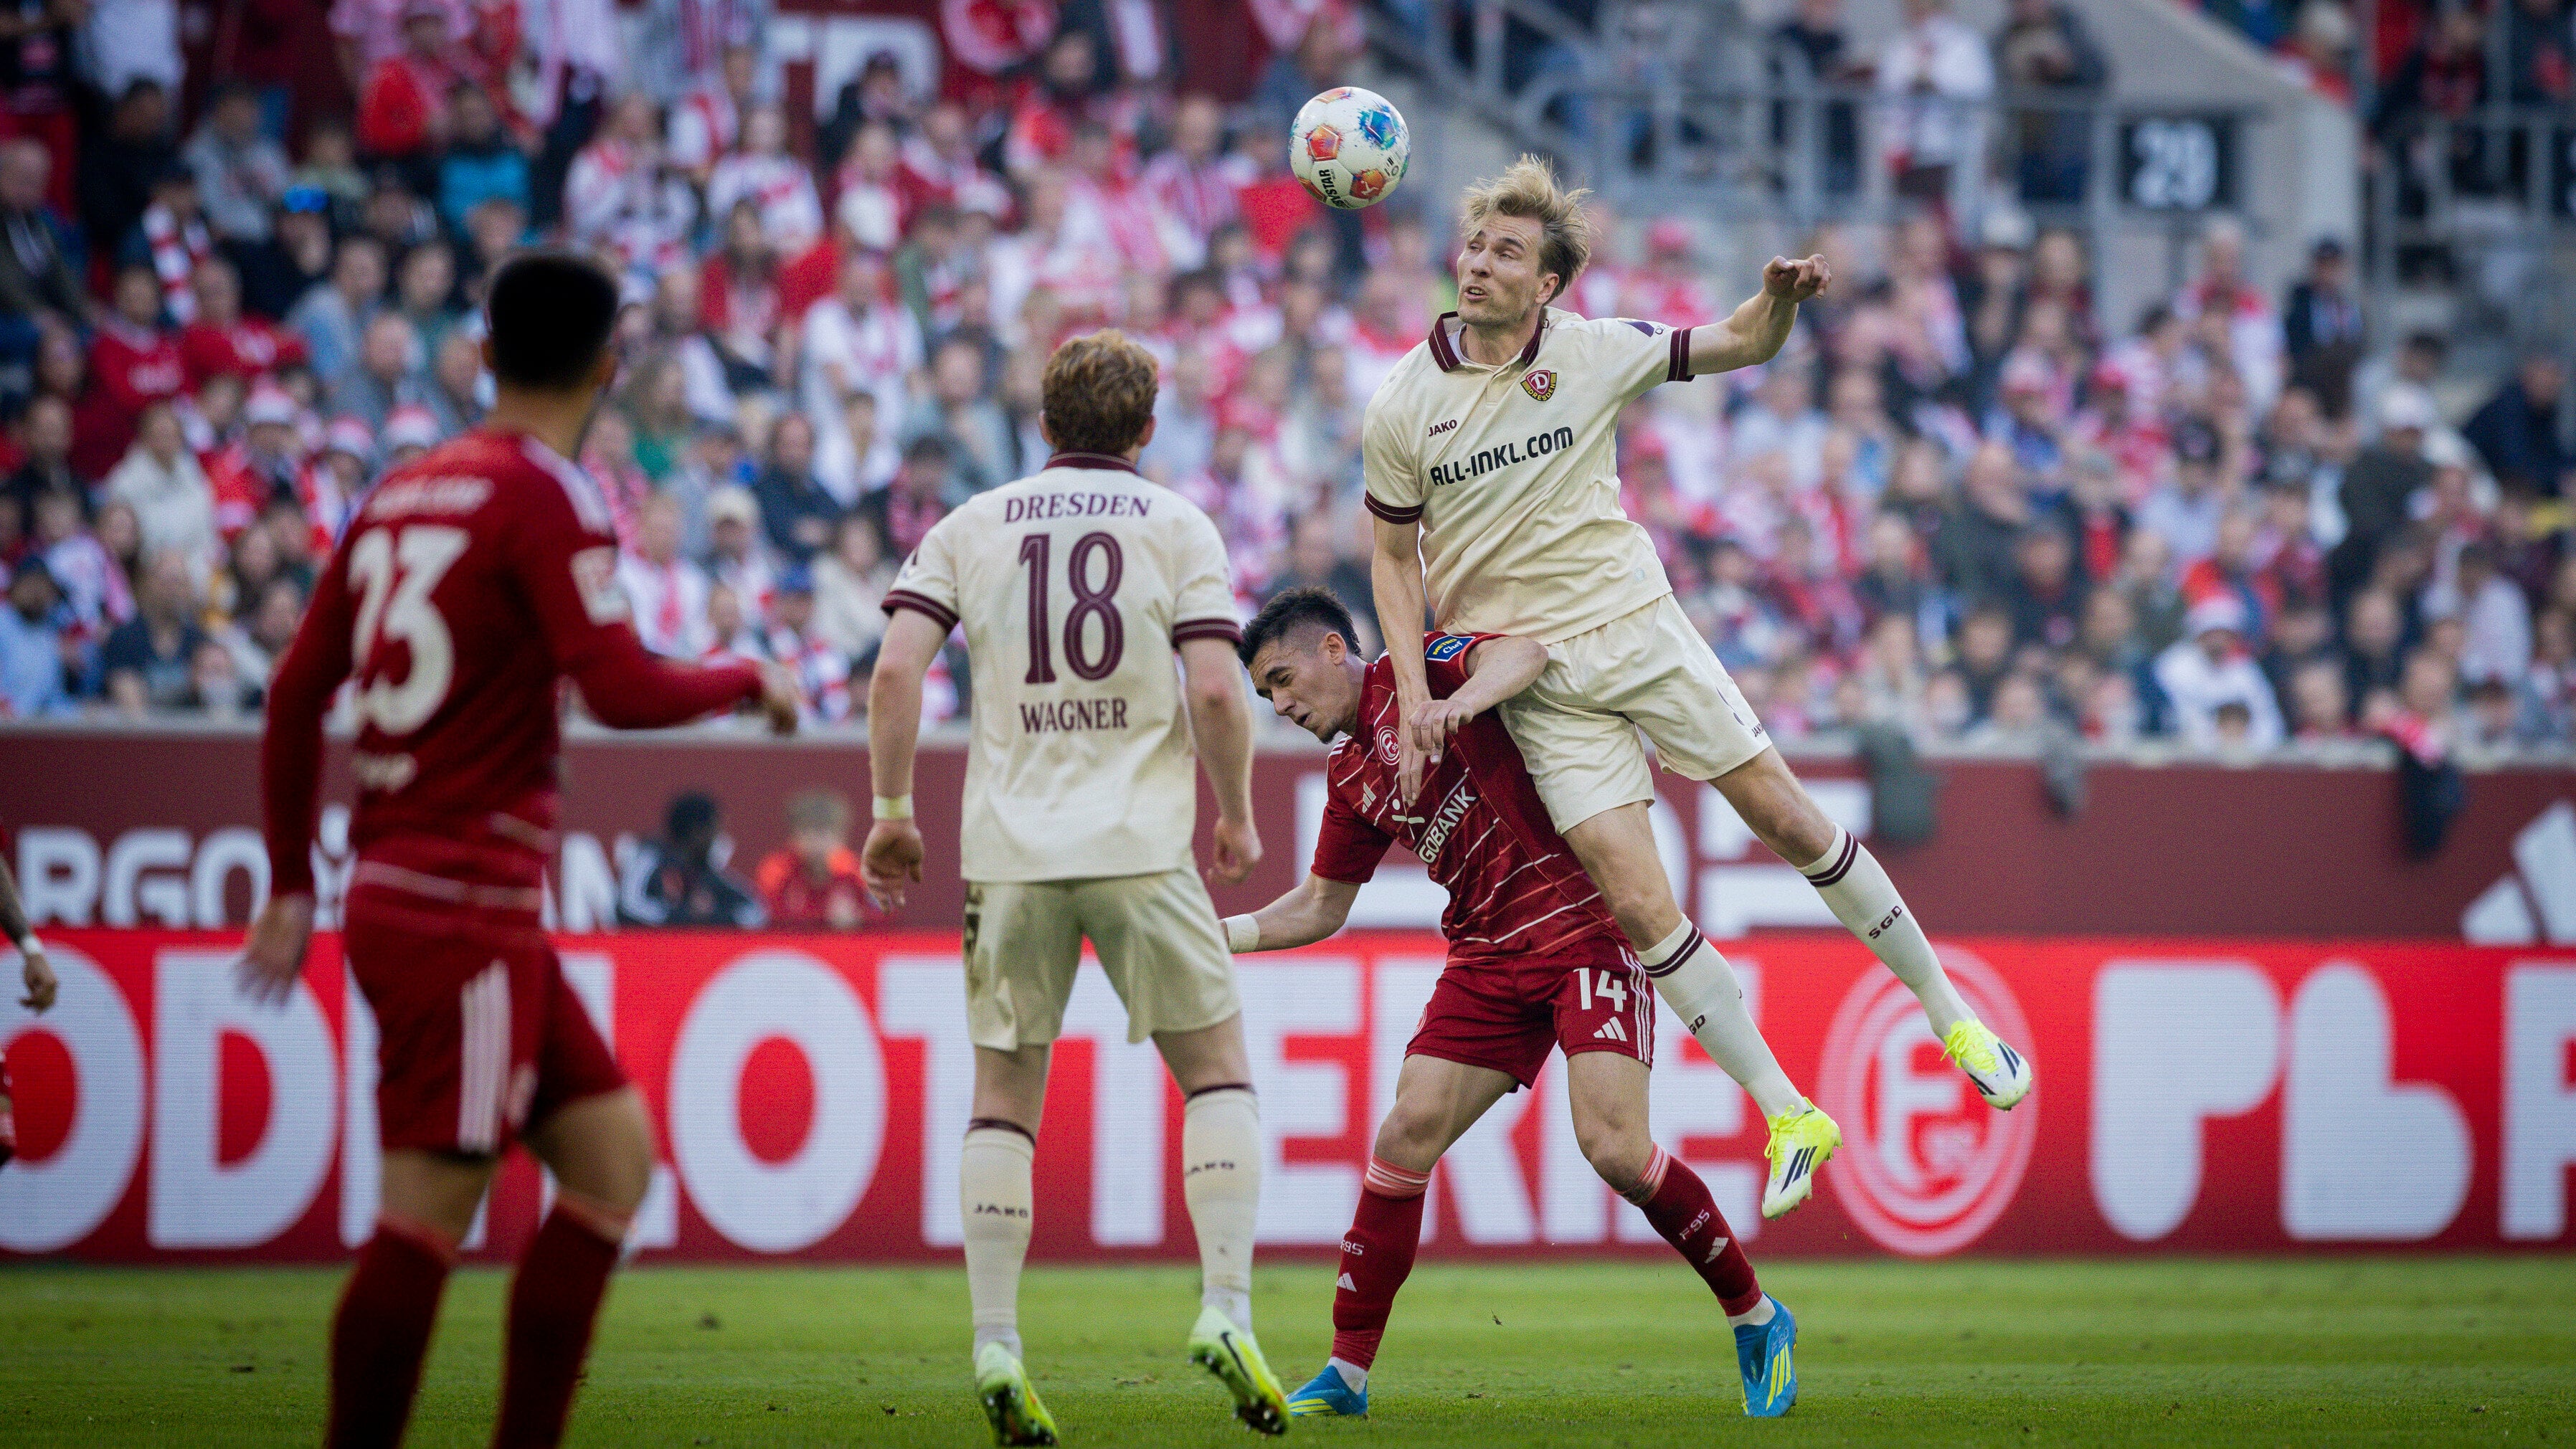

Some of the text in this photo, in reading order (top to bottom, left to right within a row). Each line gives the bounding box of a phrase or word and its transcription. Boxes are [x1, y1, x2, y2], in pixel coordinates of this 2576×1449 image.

[1528, 383, 1556, 401] DRESDEN
[1428, 419, 1457, 437] JAKO
[1430, 426, 1573, 486] ALL-INKL.COM
[1005, 492, 1151, 523] DRESDEN
[1018, 531, 1124, 685] 18
[347, 526, 472, 736] 23
[1443, 640, 1462, 654] Chef
[1019, 695, 1128, 734] WAGNER
[1419, 786, 1477, 863] GOBANK
[1869, 905, 1903, 939] SGD
[1573, 967, 1627, 1012] 14
[974, 1203, 1028, 1217] JAKO
